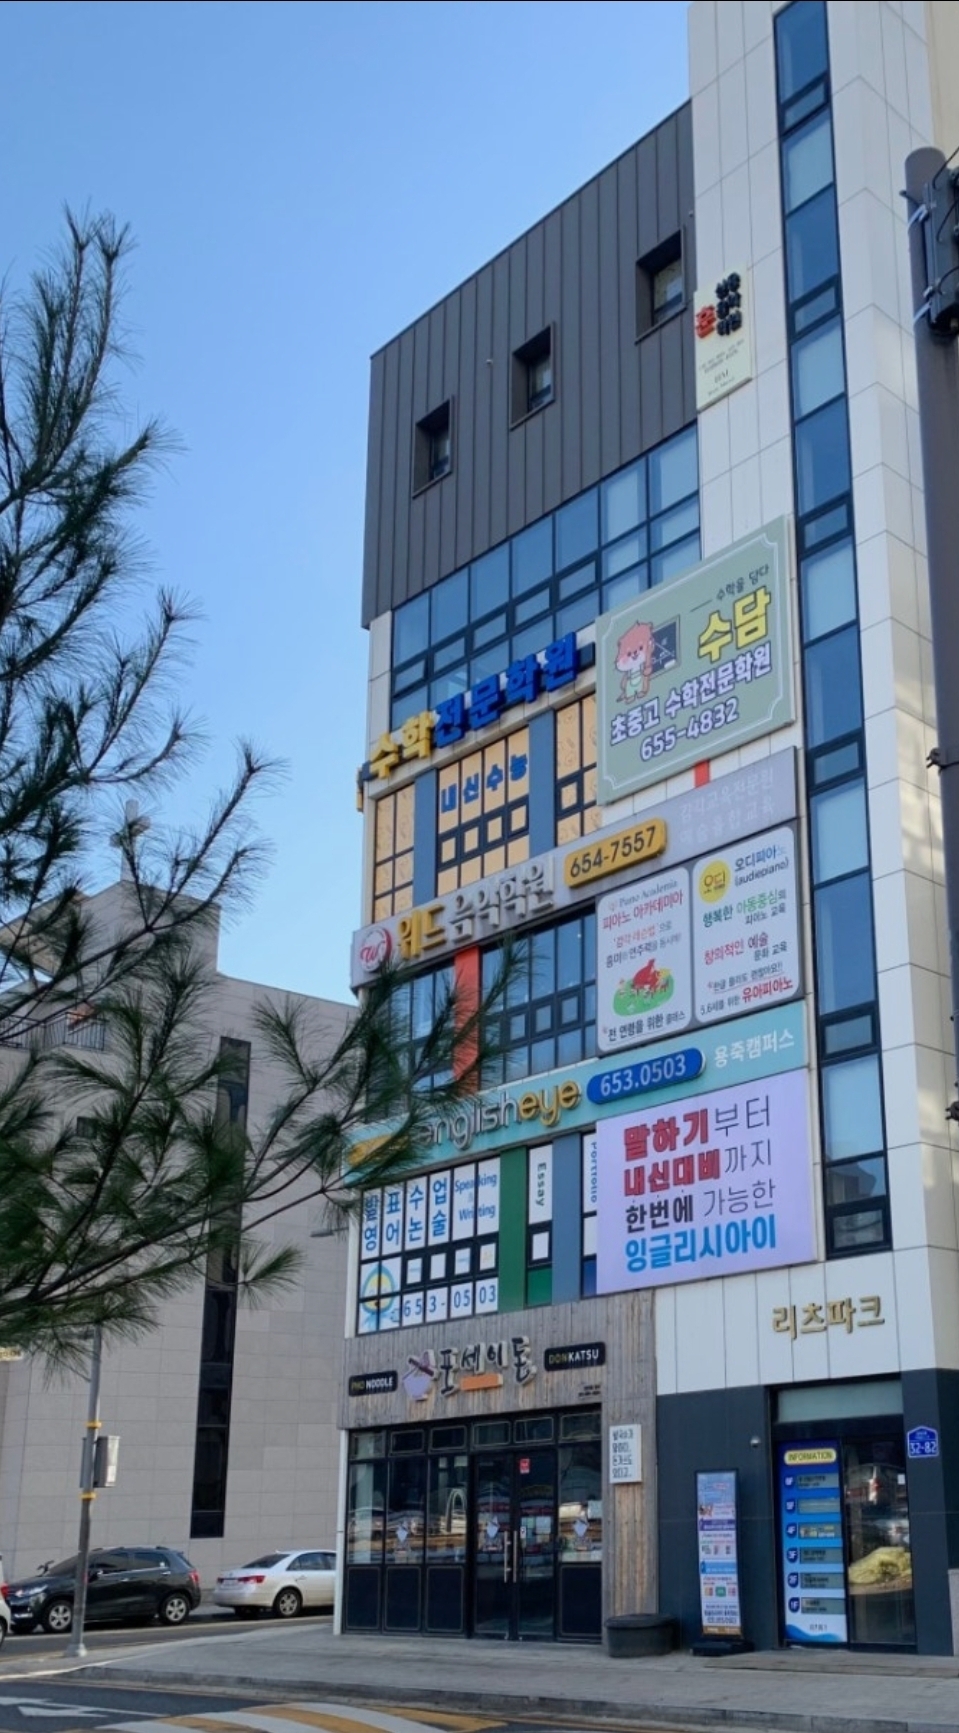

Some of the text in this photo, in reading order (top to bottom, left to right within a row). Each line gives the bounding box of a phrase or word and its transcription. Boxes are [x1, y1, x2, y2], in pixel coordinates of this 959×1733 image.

[716, 576, 745, 601] 수학을
[698, 585, 772, 664] 수담
[369, 631, 579, 779] 수학전문학원
[610, 641, 772, 745] 초중고 수학전문학원
[640, 697, 739, 762] 655-4832
[570, 825, 656, 878] 654-7557
[397, 856, 554, 960] 위드 음악학원
[603, 889, 683, 931] 피아노 아카데미아
[703, 904, 733, 928] 행복한
[705, 938, 744, 966] 창의적인
[742, 976, 793, 1004] 유아피아노
[713, 1028, 795, 1069] 용죽캠퍼스
[600, 1054, 687, 1097] 653.0503
[623, 1095, 770, 1162] 말하기부터
[537, 1162, 547, 1207] Essay
[623, 1139, 772, 1197] 내신대비까지
[626, 1179, 775, 1234] 한번에 가능한
[625, 1214, 776, 1274] 잉글리시아이
[772, 1295, 885, 1341] 리츠파크
[366, 1376, 394, 1388] NOODLE
[787, 1451, 833, 1462] INFORMATION
[910, 1441, 936, 1454] 32-82
